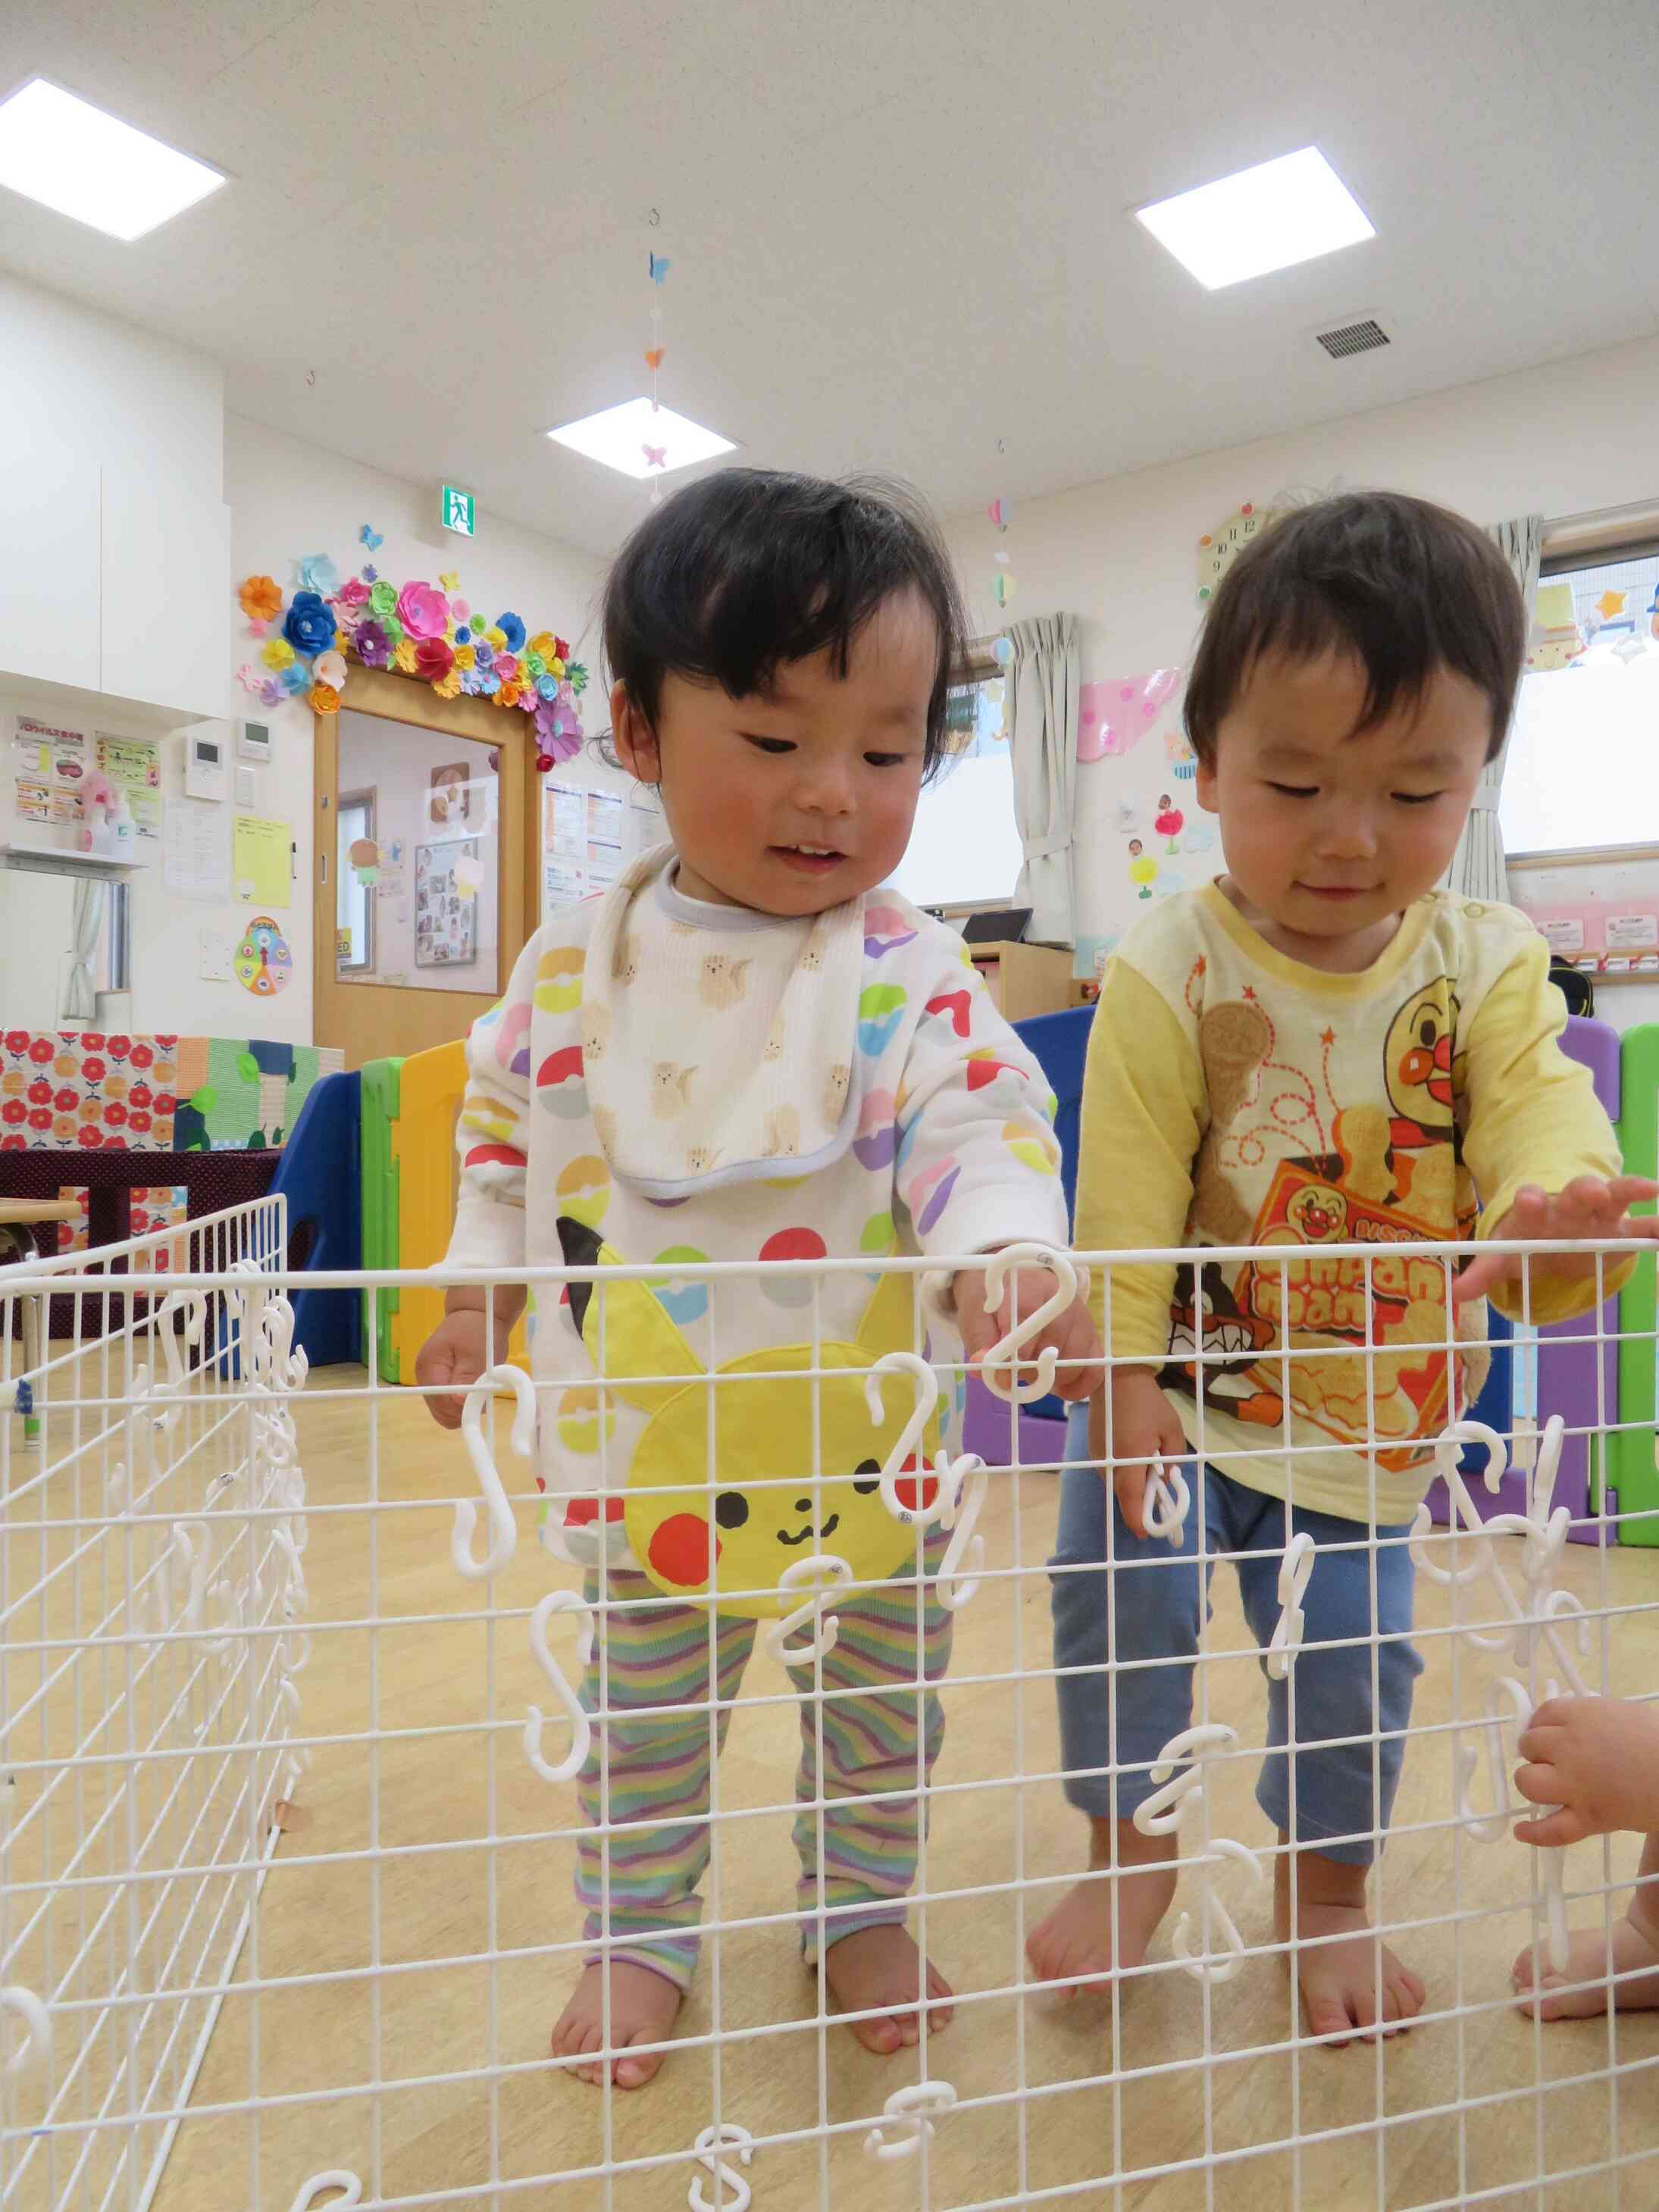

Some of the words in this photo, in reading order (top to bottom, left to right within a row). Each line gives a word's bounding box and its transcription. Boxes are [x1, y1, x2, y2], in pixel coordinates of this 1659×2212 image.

[1244, 520, 1255, 533] 12
[1229, 528, 1237, 540] 11
[1218, 543, 1227, 554] 10
